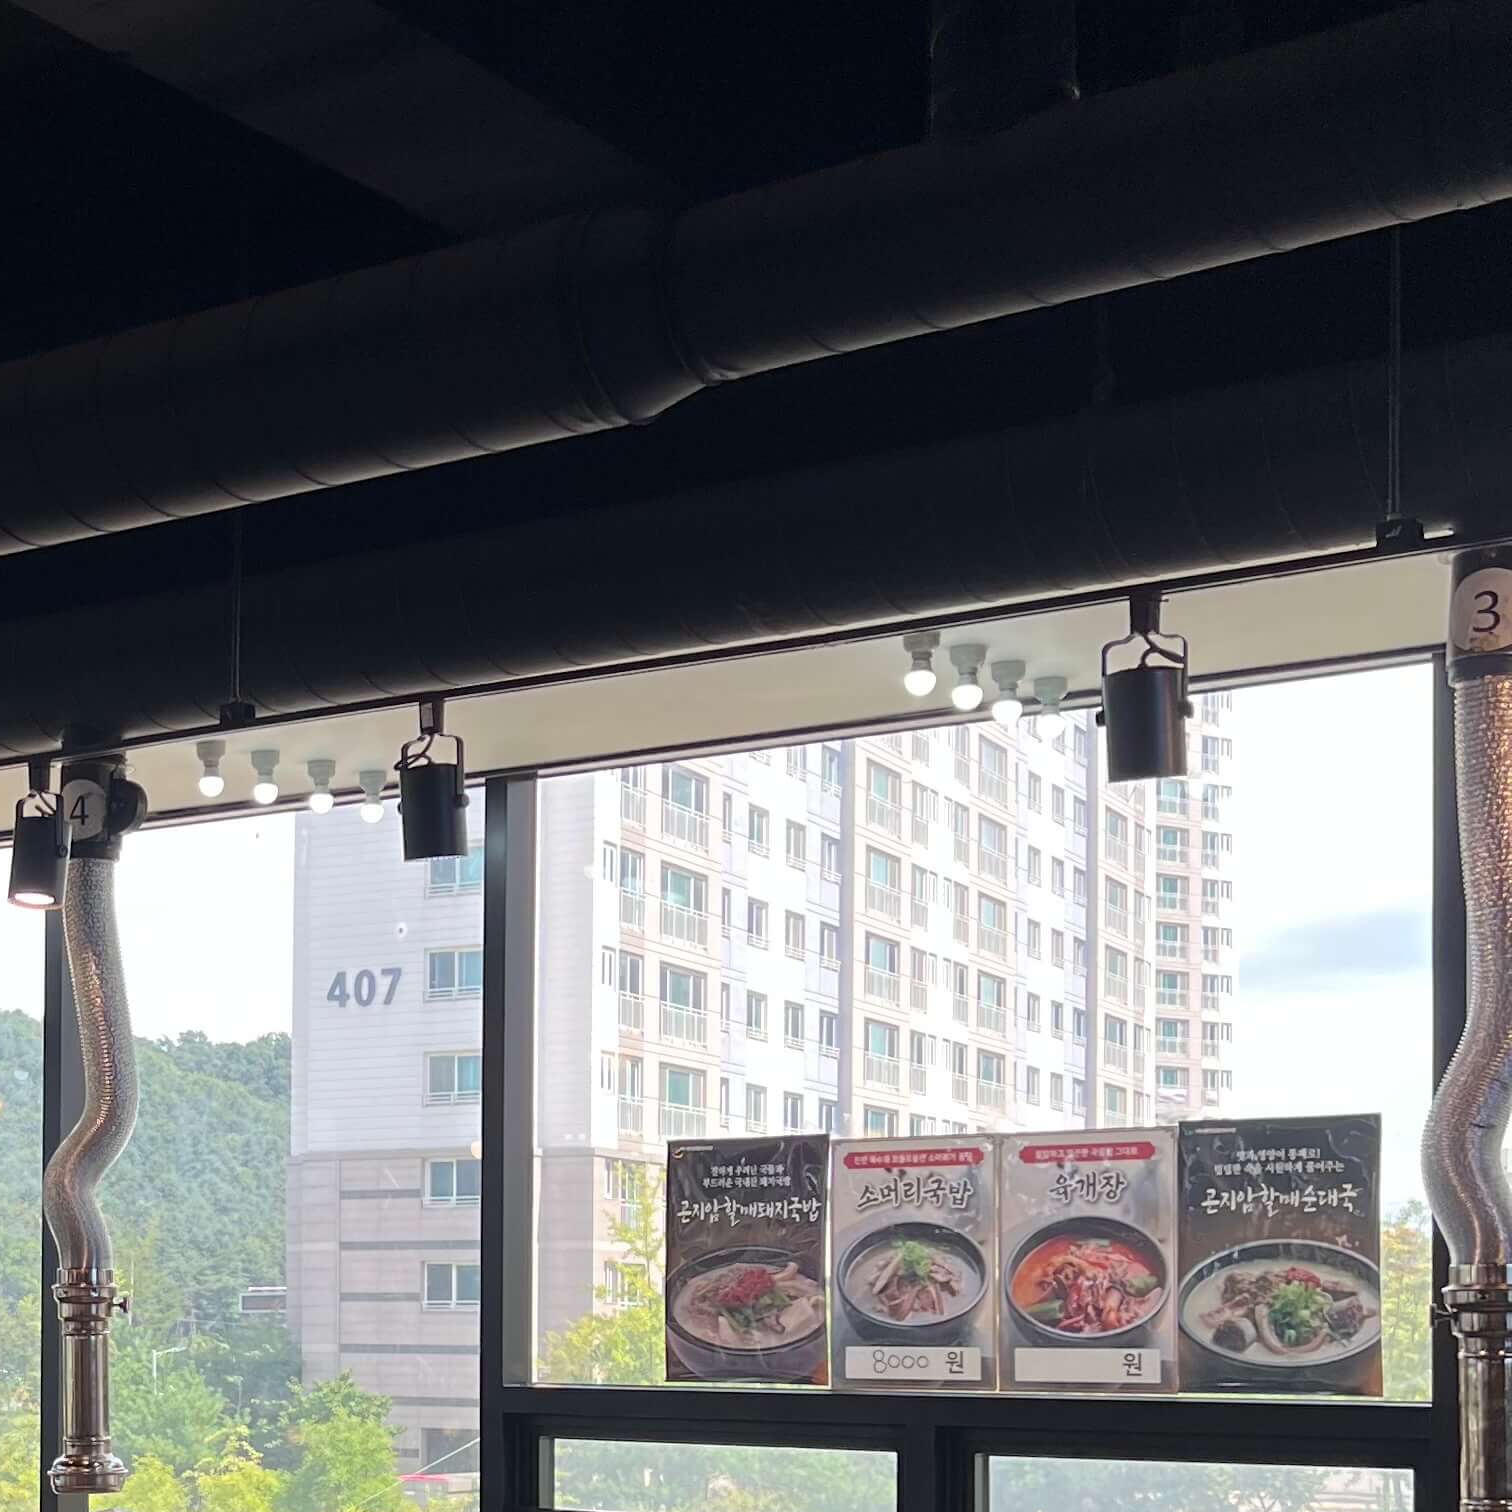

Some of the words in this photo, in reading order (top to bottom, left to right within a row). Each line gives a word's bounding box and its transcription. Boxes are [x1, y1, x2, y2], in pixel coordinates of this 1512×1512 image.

[1472, 590, 1500, 632] 3
[70, 795, 89, 825] 4
[326, 967, 402, 1008] 407
[856, 1176, 973, 1208] 소머리국밥
[1049, 1171, 1126, 1202] 육개장
[873, 1350, 929, 1374] 8000
[945, 1350, 965, 1375] 원
[1122, 1352, 1143, 1377] 원
